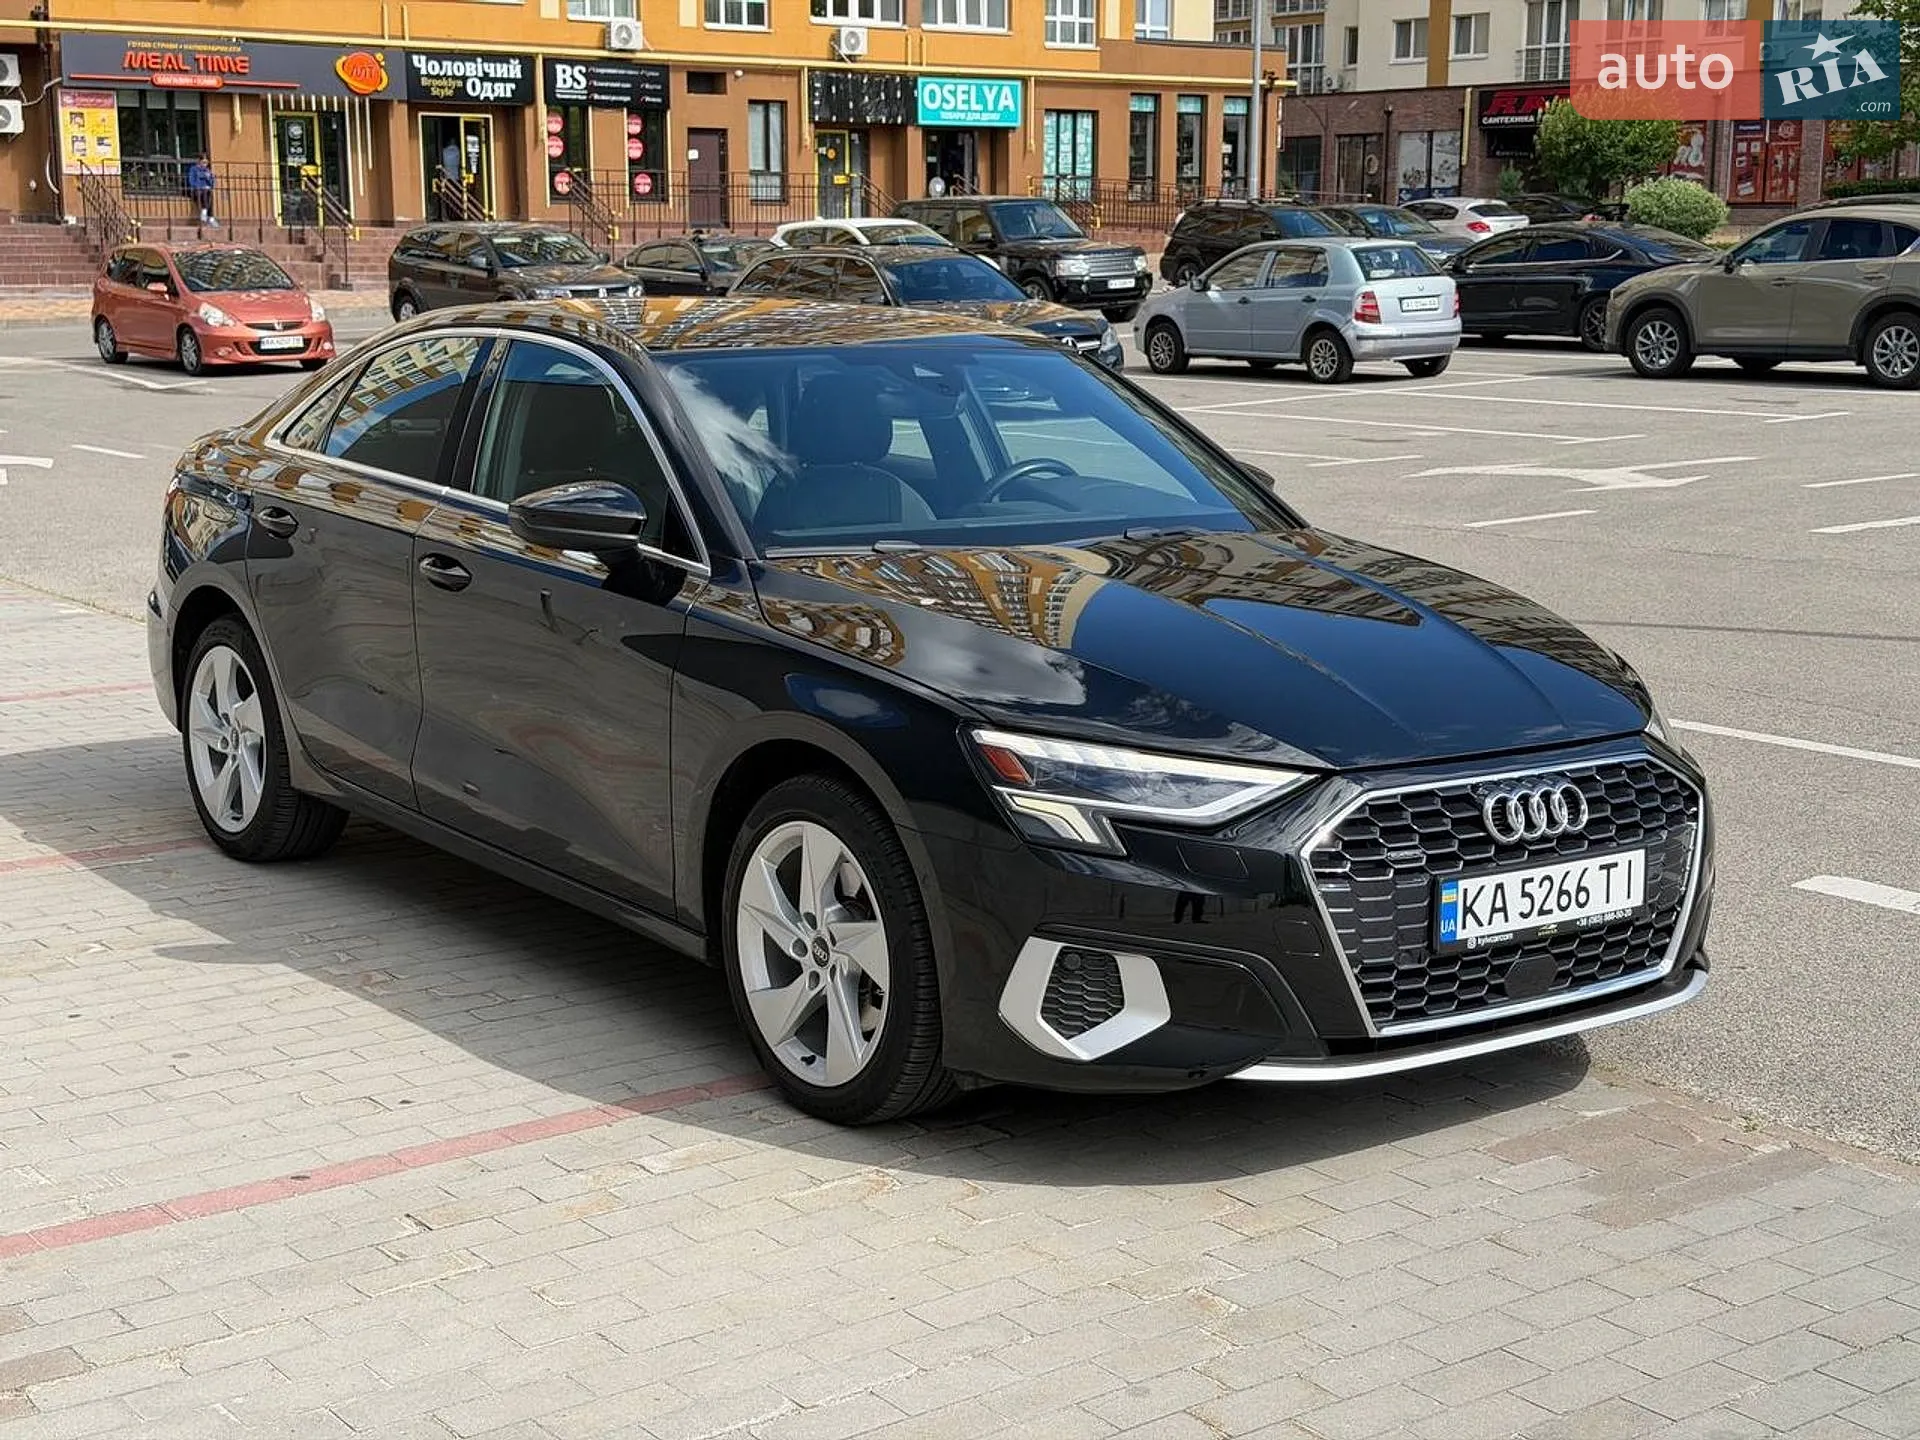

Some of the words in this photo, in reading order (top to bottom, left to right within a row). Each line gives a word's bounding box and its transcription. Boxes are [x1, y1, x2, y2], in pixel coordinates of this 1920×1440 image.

[122, 50, 191, 71] MEAL
[194, 52, 250, 74] TIME
[412, 54, 522, 79] Чоловічий
[421, 76, 463, 89] Brooklyn
[555, 63, 587, 89] BS
[430, 86, 454, 98] Style
[466, 78, 516, 100] Одяг
[922, 82, 1016, 112] OSELYA
[1461, 881, 1509, 930] KA
[1518, 867, 1591, 920] 5266
[1599, 859, 1632, 904] TI
[1440, 919, 1455, 933] UA
